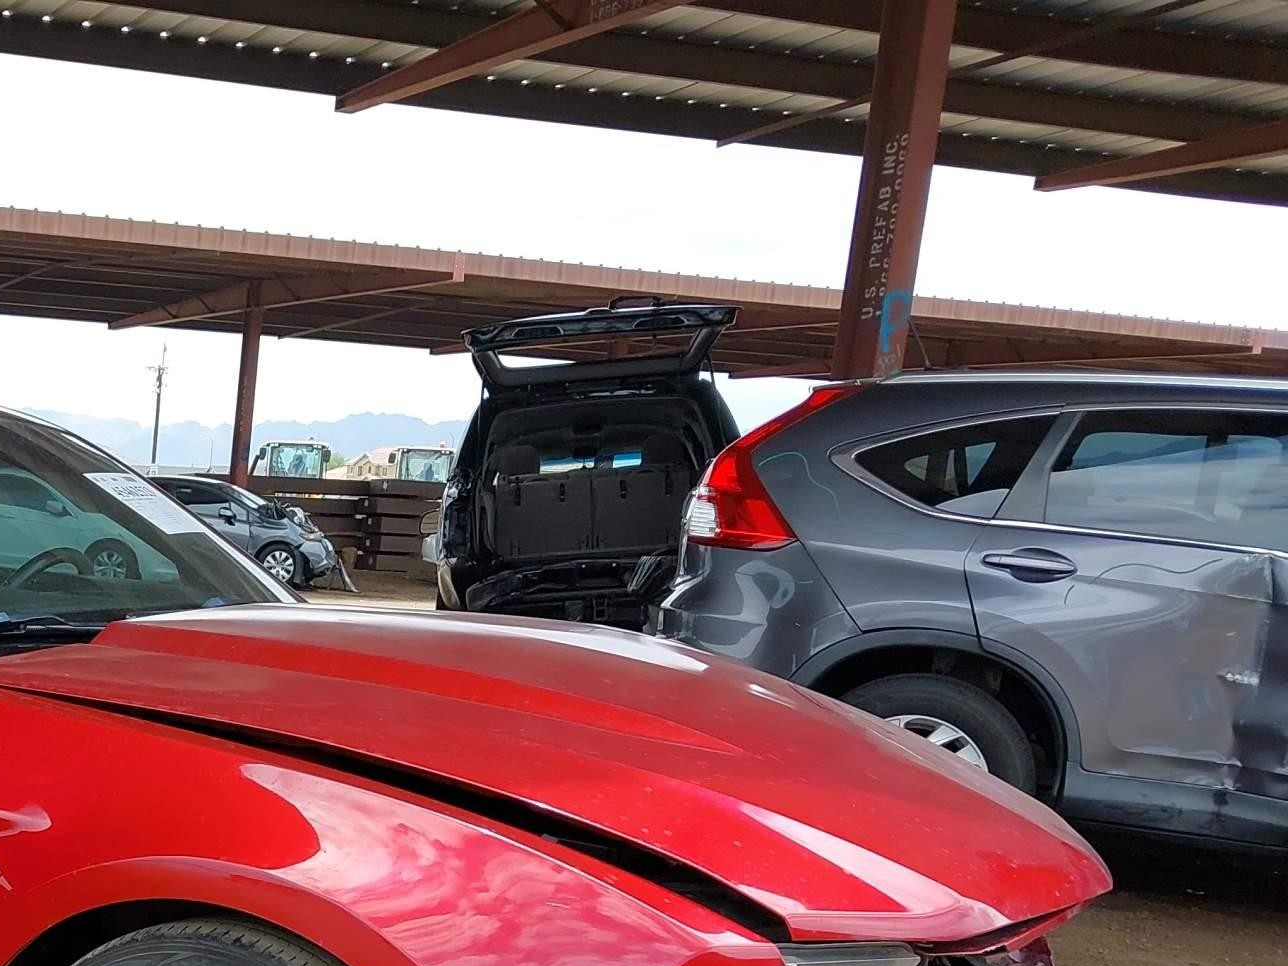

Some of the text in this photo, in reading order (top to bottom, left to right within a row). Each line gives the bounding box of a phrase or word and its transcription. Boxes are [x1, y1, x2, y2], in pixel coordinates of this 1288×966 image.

[861, 134, 898, 320] U.S. PREFAB INC.
